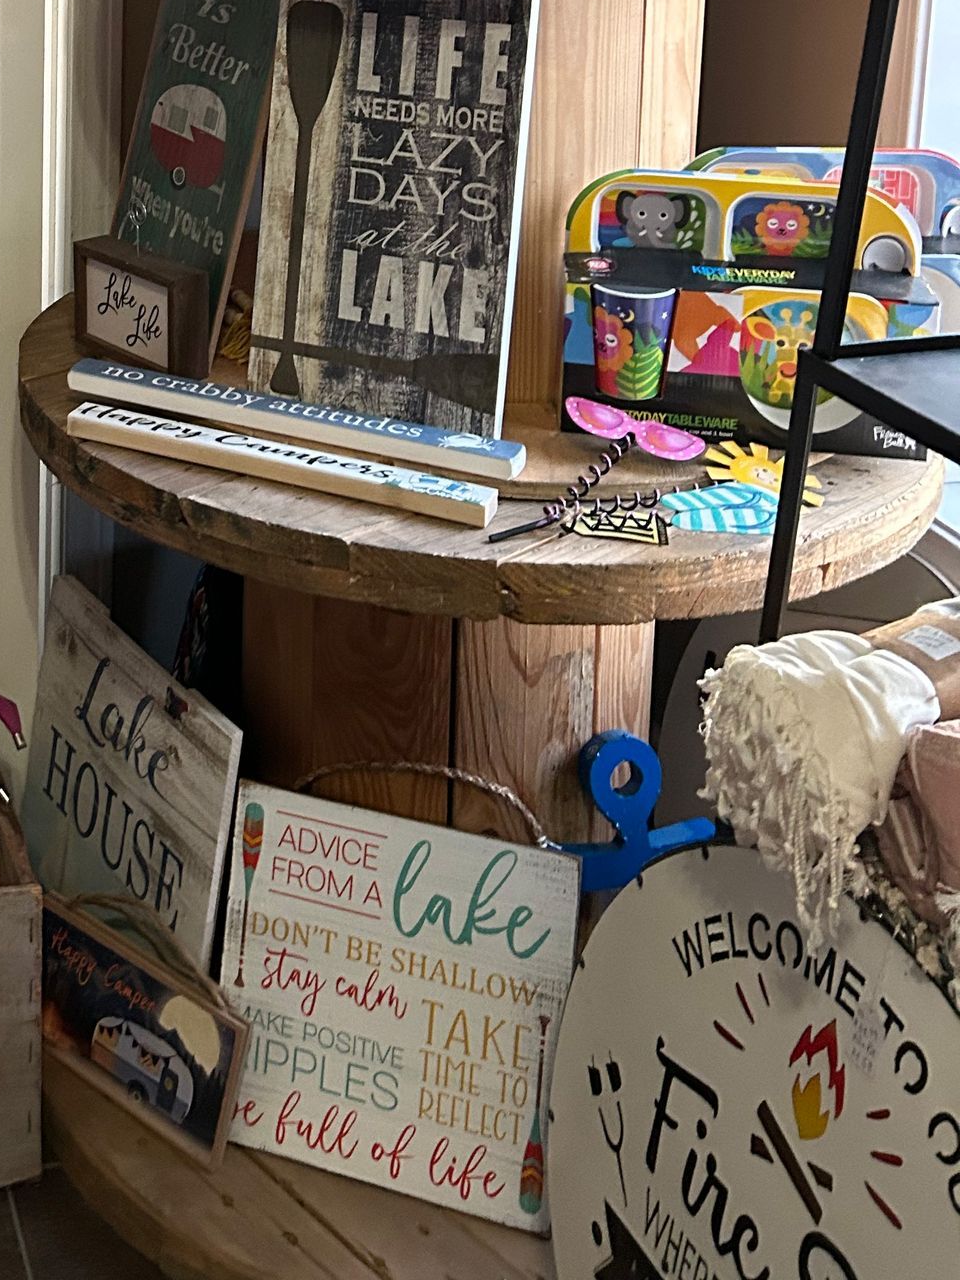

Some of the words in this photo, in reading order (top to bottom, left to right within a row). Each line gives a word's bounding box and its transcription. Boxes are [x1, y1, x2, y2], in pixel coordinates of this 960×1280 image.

[167, 22, 251, 88] Better
[355, 11, 513, 106] LIFE
[347, 122, 505, 179] LAZY
[353, 94, 431, 128] NEEDS
[436, 103, 505, 134] MORE
[128, 175, 171, 225] When
[168, 205, 225, 256] you're
[347, 167, 498, 222] DAYS
[346, 221, 406, 252] at
[403, 221, 469, 260] the
[691, 264, 726, 277] KID'S
[725, 267, 796, 280] EVERYDAY
[97, 272, 137, 316] Lake
[337, 249, 490, 344] LAKE
[705, 274, 788, 285] TABLEWARE
[125, 303, 163, 348] Life
[102, 364, 144, 382] no
[151, 372, 265, 409] crabby
[268, 396, 424, 439] attitudes
[625, 409, 667, 424] RYDAY
[667, 412, 739, 431] TABLEWARE
[79, 403, 202, 440] Happy
[214, 433, 397, 480] Campers
[74, 656, 172, 805] Lake
[42, 724, 184, 934] HOUSE
[277, 823, 380, 871] ADVICE
[270, 856, 354, 901] FROM
[363, 883, 384, 909] A
[393, 839, 552, 960] lake
[50, 926, 98, 986] Happy
[103, 963, 157, 1013] Camper
[249, 910, 338, 954] DON'T
[344, 934, 384, 968] BE
[389, 946, 542, 1008] SHALLOW
[260, 947, 327, 1018] stay
[334, 968, 409, 1020] calm
[671, 911, 867, 1018] WELCOME
[302, 1021, 405, 1070] POSITIVE
[420, 998, 535, 1074] TAKE
[243, 1035, 400, 1112] IPPLES
[417, 1047, 481, 1097] TIME
[497, 1069, 530, 1109] TO
[274, 1089, 359, 1160] full
[370, 1123, 419, 1181] of
[428, 1136, 507, 1202] life
[417, 1085, 526, 1146] REFLECT
[645, 1035, 771, 1280] Fire
[644, 1185, 725, 1280] WHE
